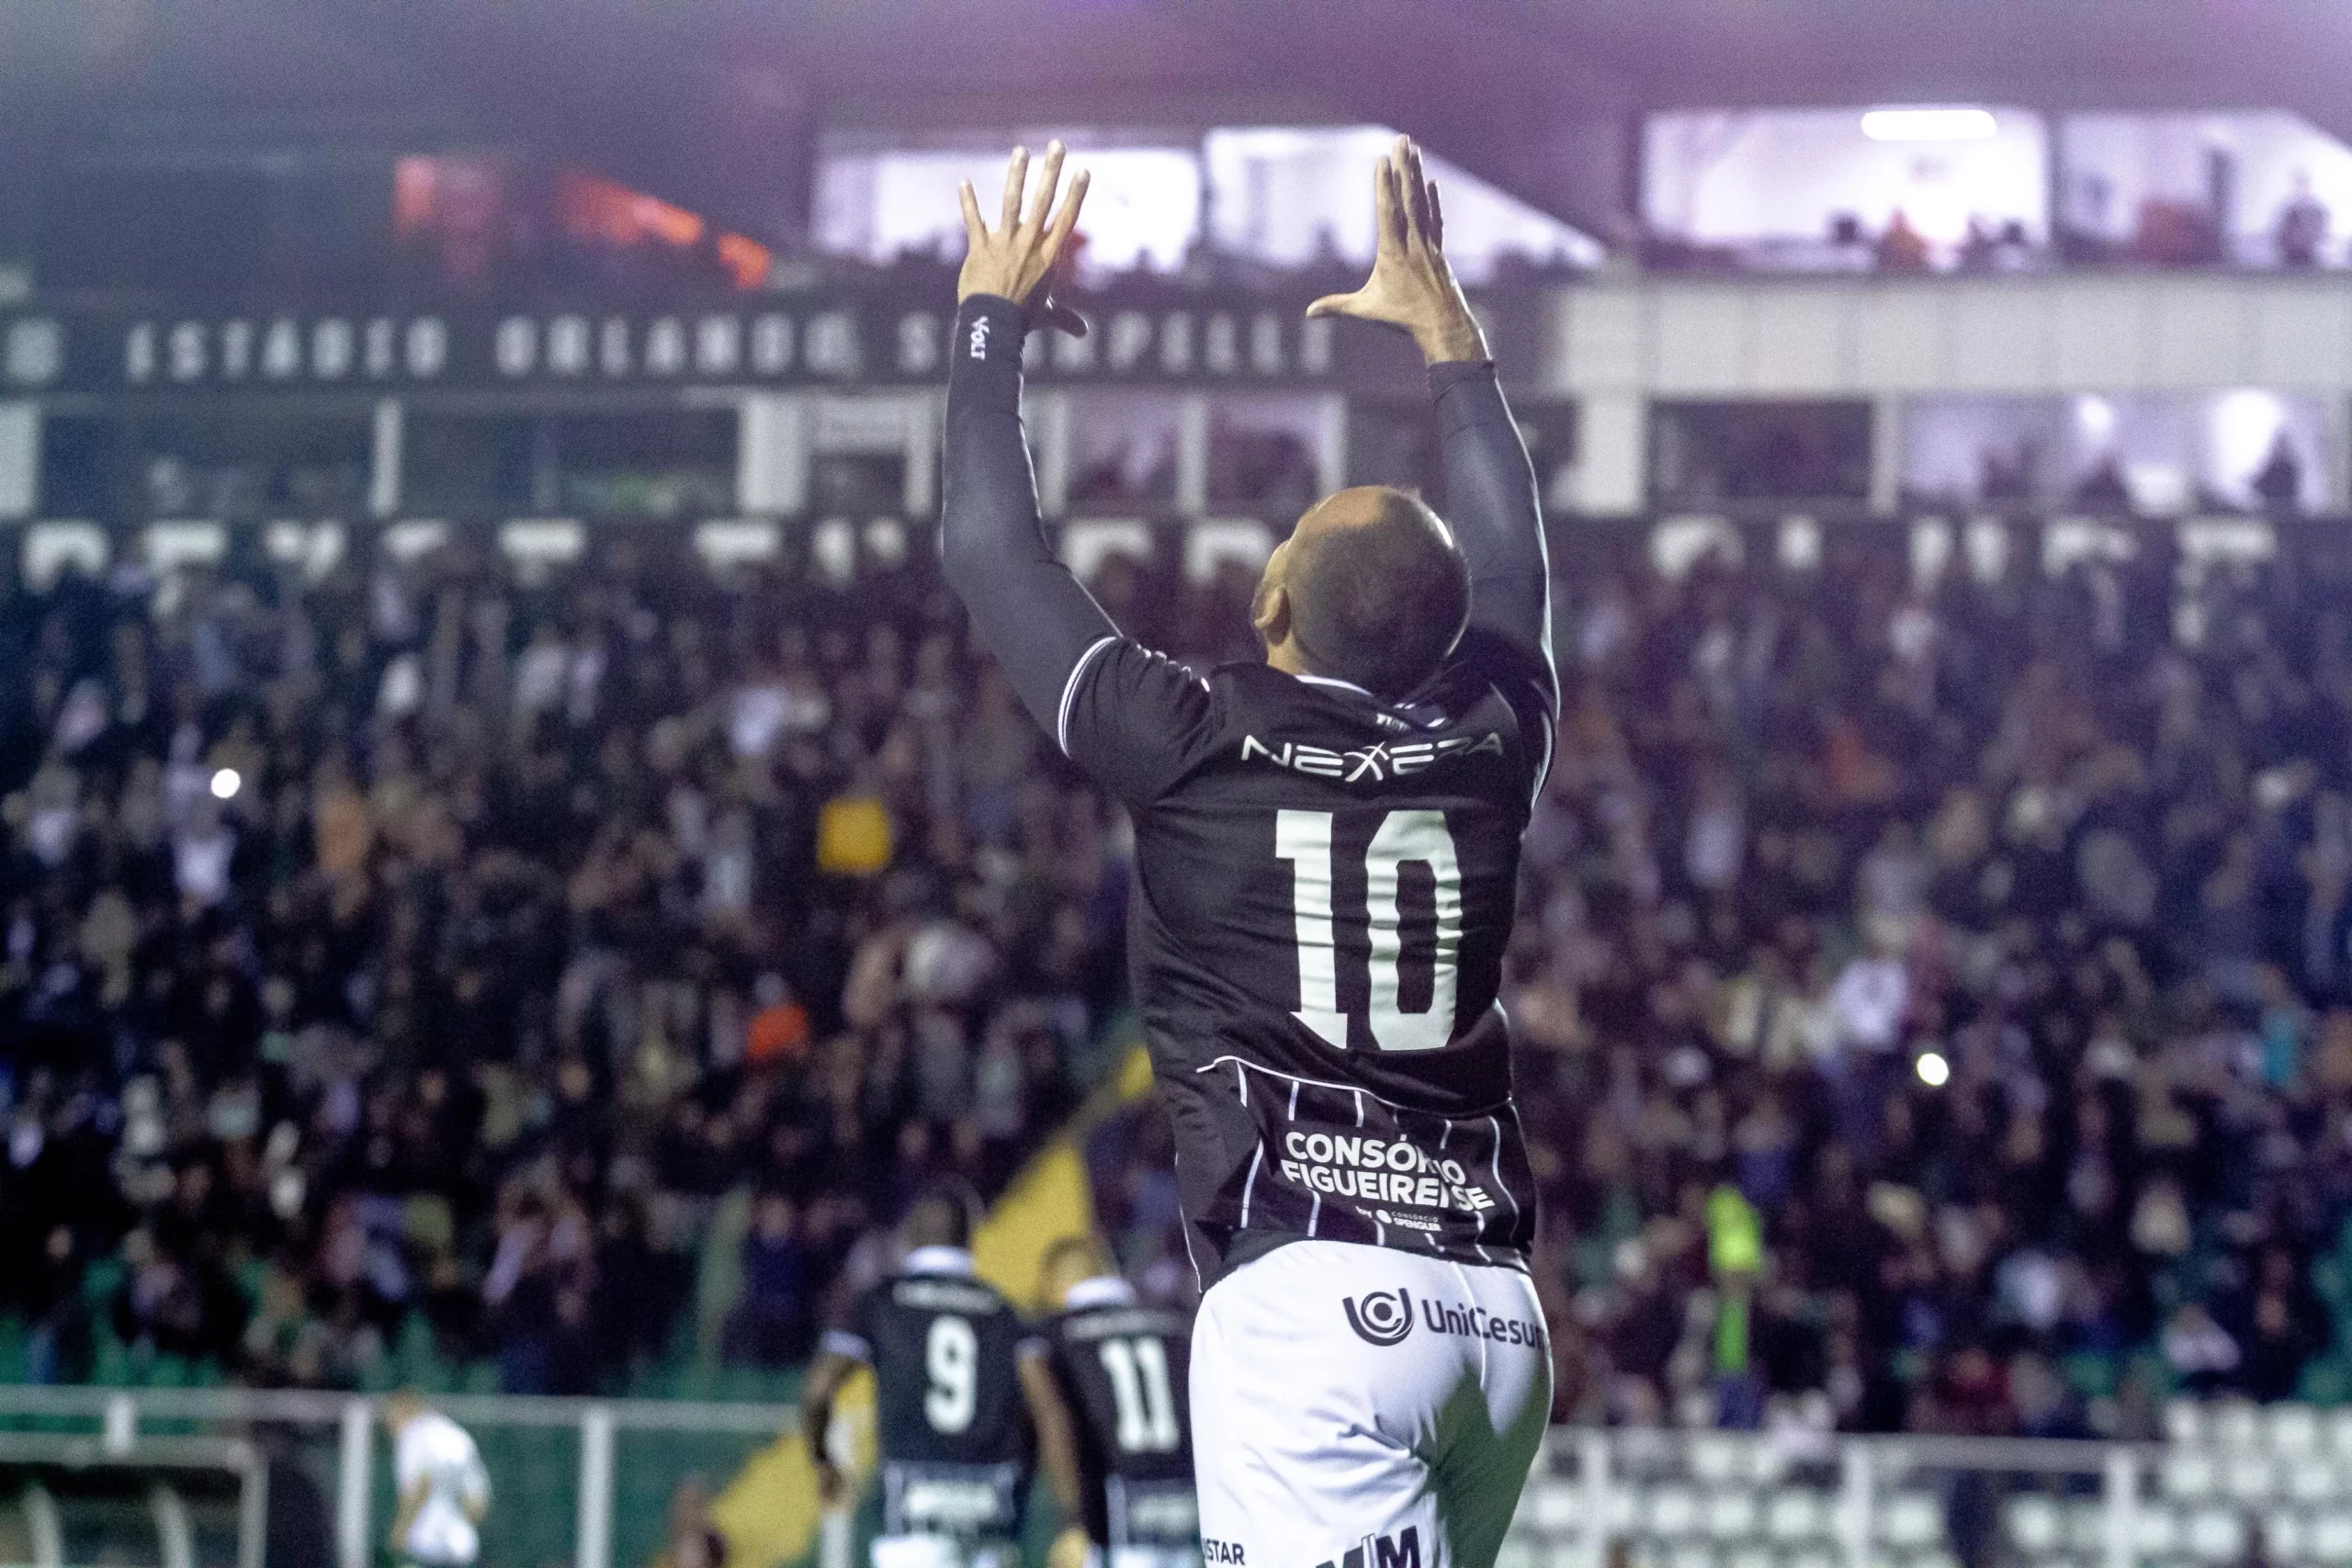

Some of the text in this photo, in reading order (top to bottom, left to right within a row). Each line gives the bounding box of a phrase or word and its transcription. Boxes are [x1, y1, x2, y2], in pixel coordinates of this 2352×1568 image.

[1276, 809, 1463, 1050] 10
[925, 1314, 978, 1434] 9
[1100, 1337, 1178, 1451] 11
